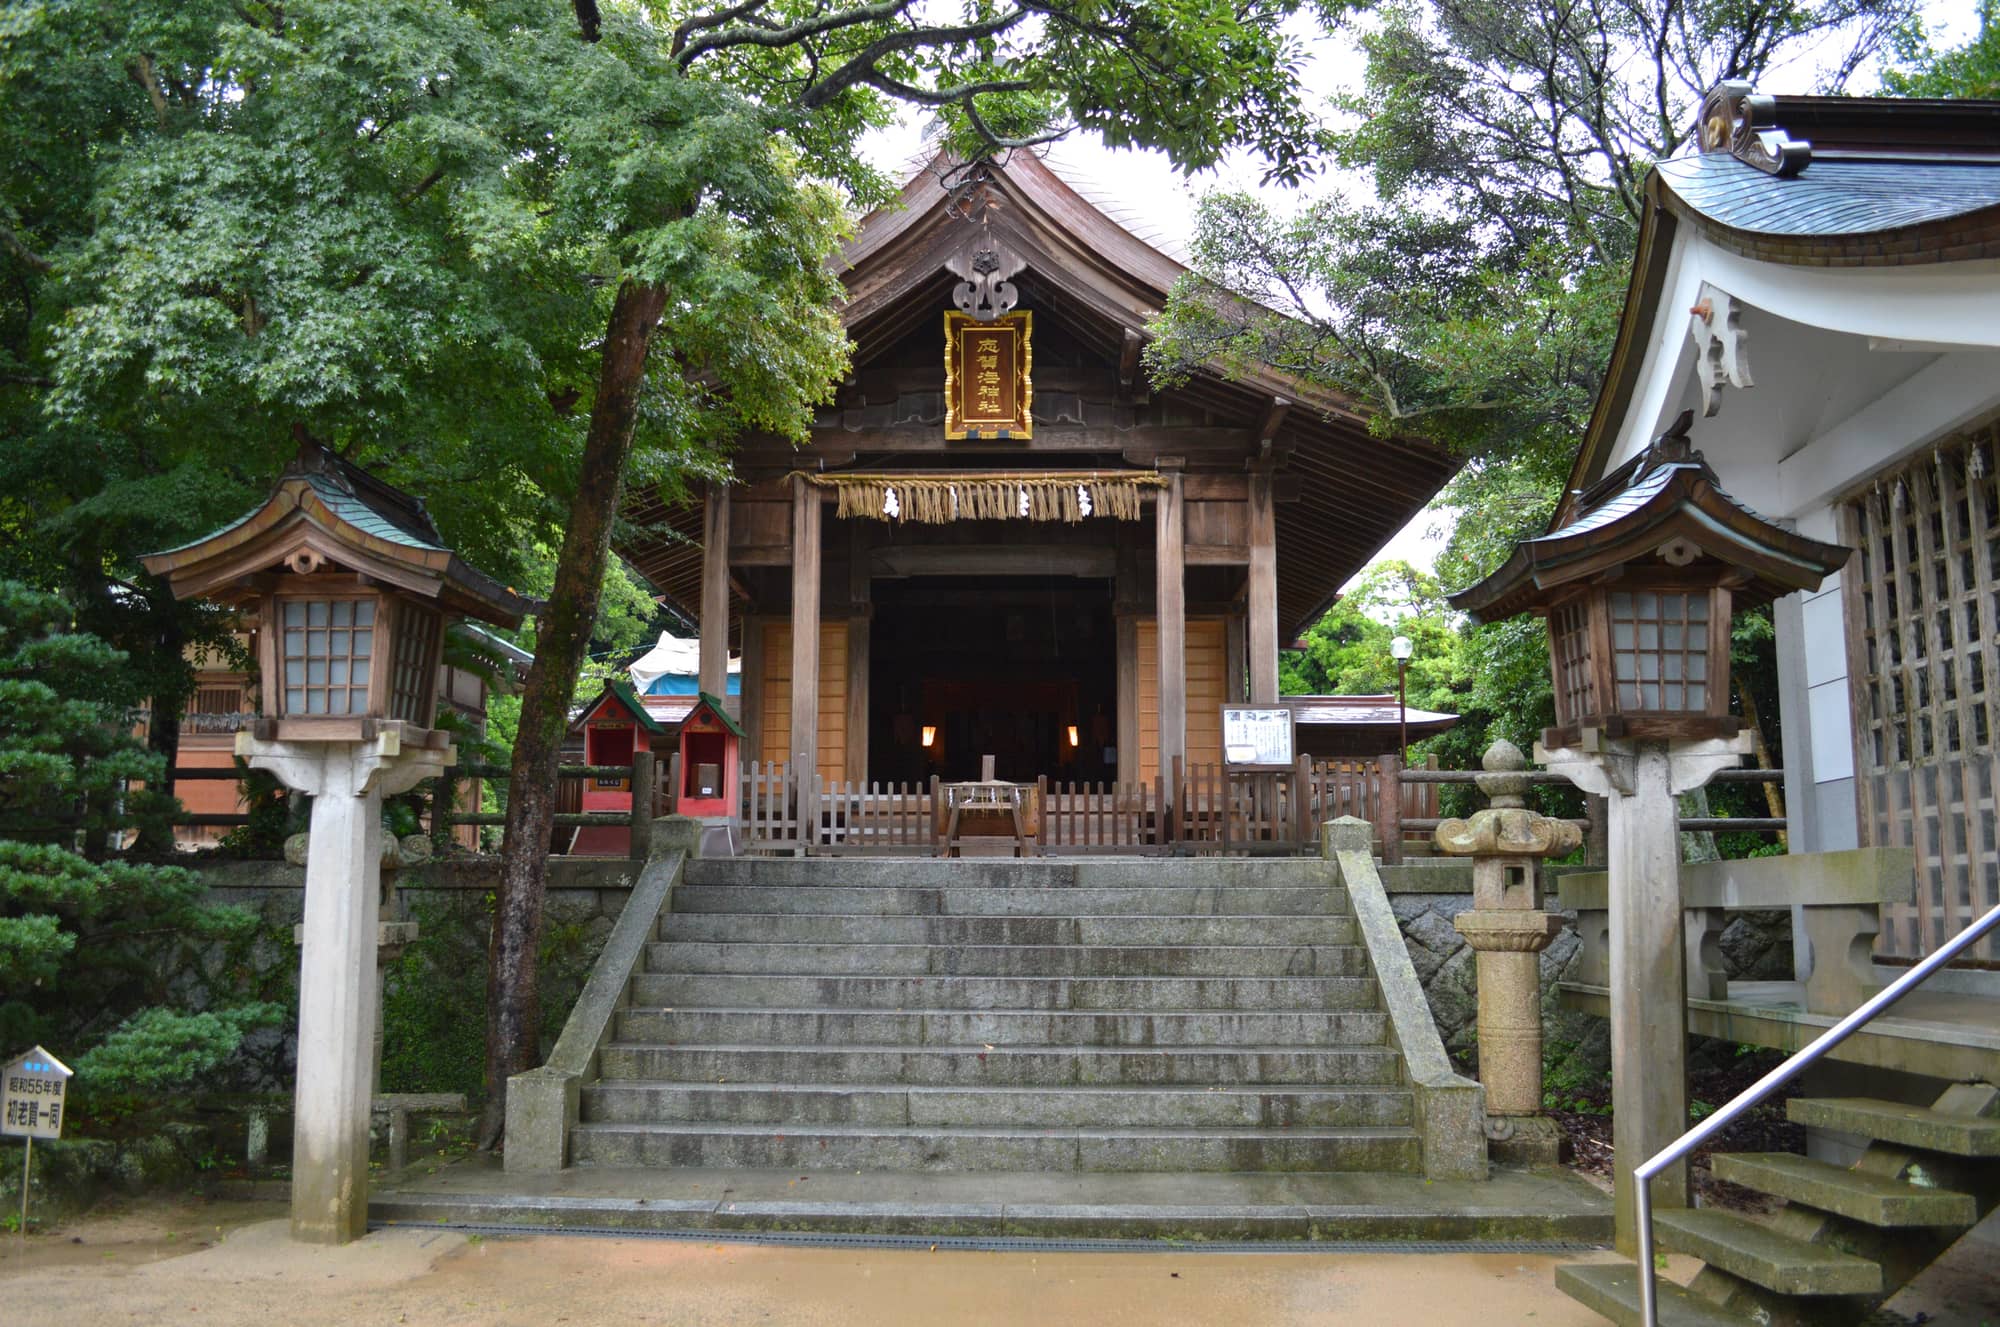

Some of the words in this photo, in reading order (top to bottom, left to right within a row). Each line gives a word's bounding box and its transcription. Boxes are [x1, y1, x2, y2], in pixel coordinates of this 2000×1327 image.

[977, 338, 1002, 413] 志賀海神社
[9, 1077, 63, 1096] 昭和55年度
[7, 1099, 60, 1128] 初老賀一同
